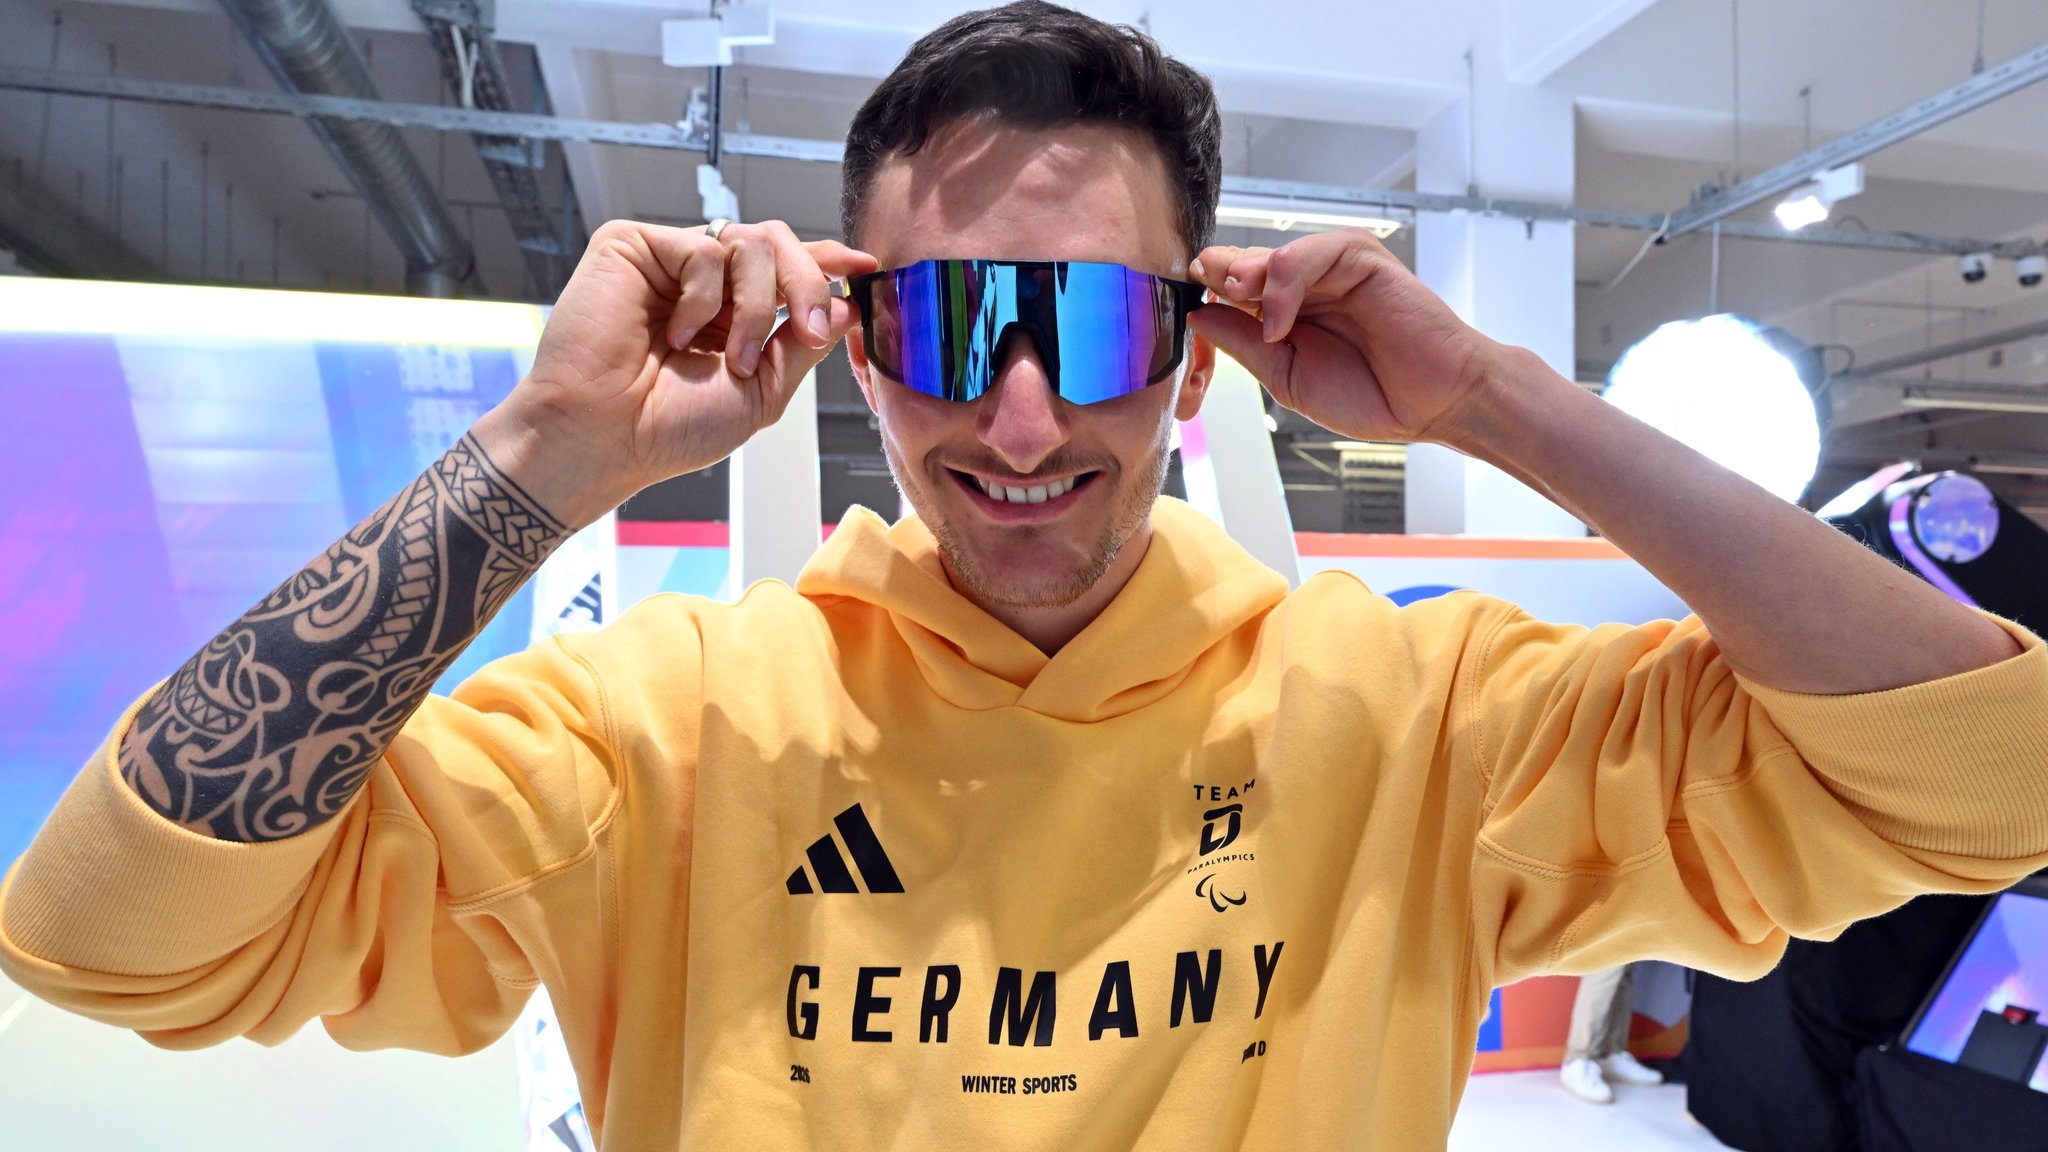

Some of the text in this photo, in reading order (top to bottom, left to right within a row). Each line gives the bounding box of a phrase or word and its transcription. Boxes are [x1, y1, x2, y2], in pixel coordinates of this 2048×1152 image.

[1193, 778, 1256, 801] TEAM
[1187, 853, 1255, 875] PARALYMPICS
[786, 941, 1285, 1047] GERMANY
[961, 1073, 1077, 1095] WINTER SPORTS
